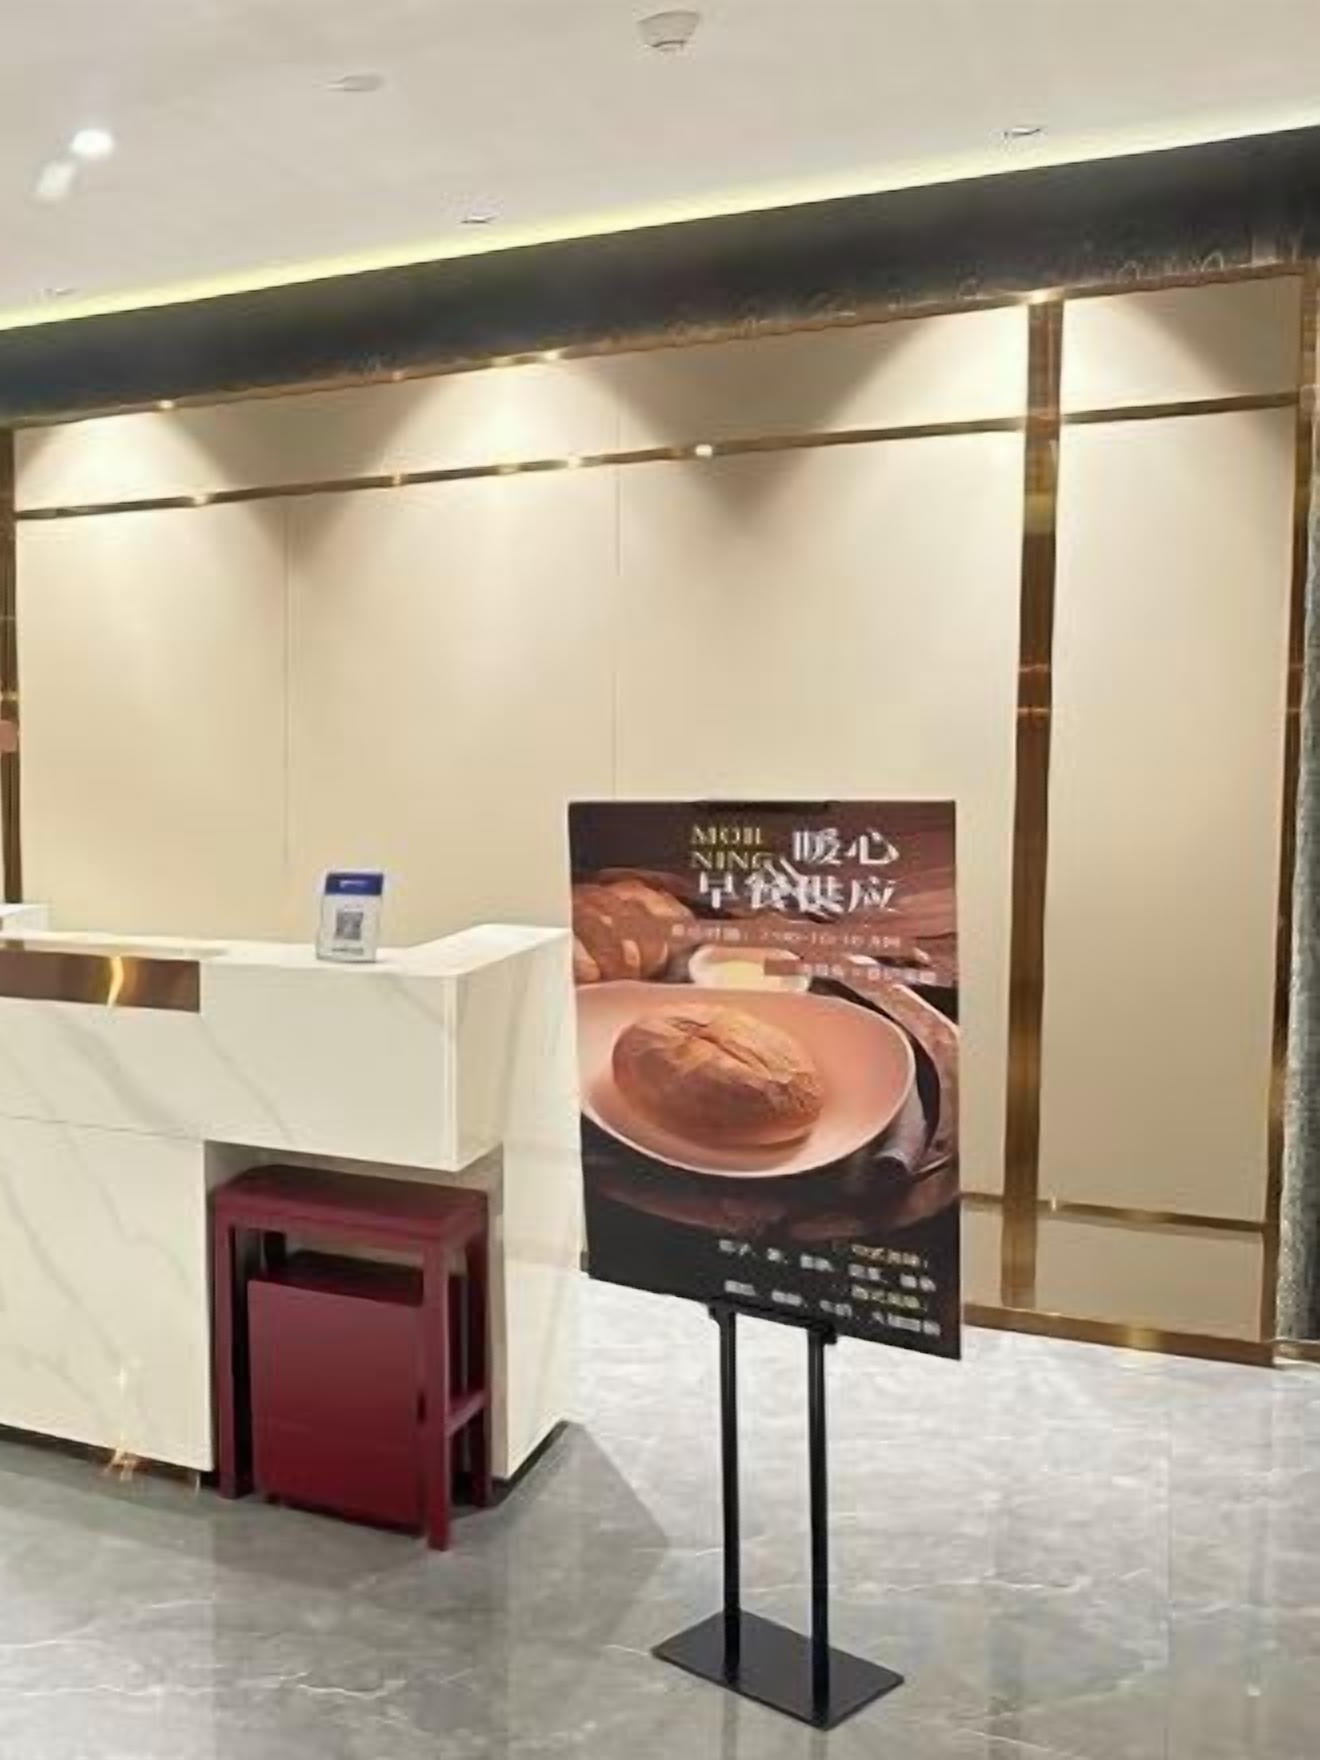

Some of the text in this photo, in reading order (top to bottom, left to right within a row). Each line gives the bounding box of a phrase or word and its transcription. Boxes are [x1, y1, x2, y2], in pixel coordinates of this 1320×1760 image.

[792, 826, 900, 866] 暖心
[698, 857, 899, 917] 早餐供应
